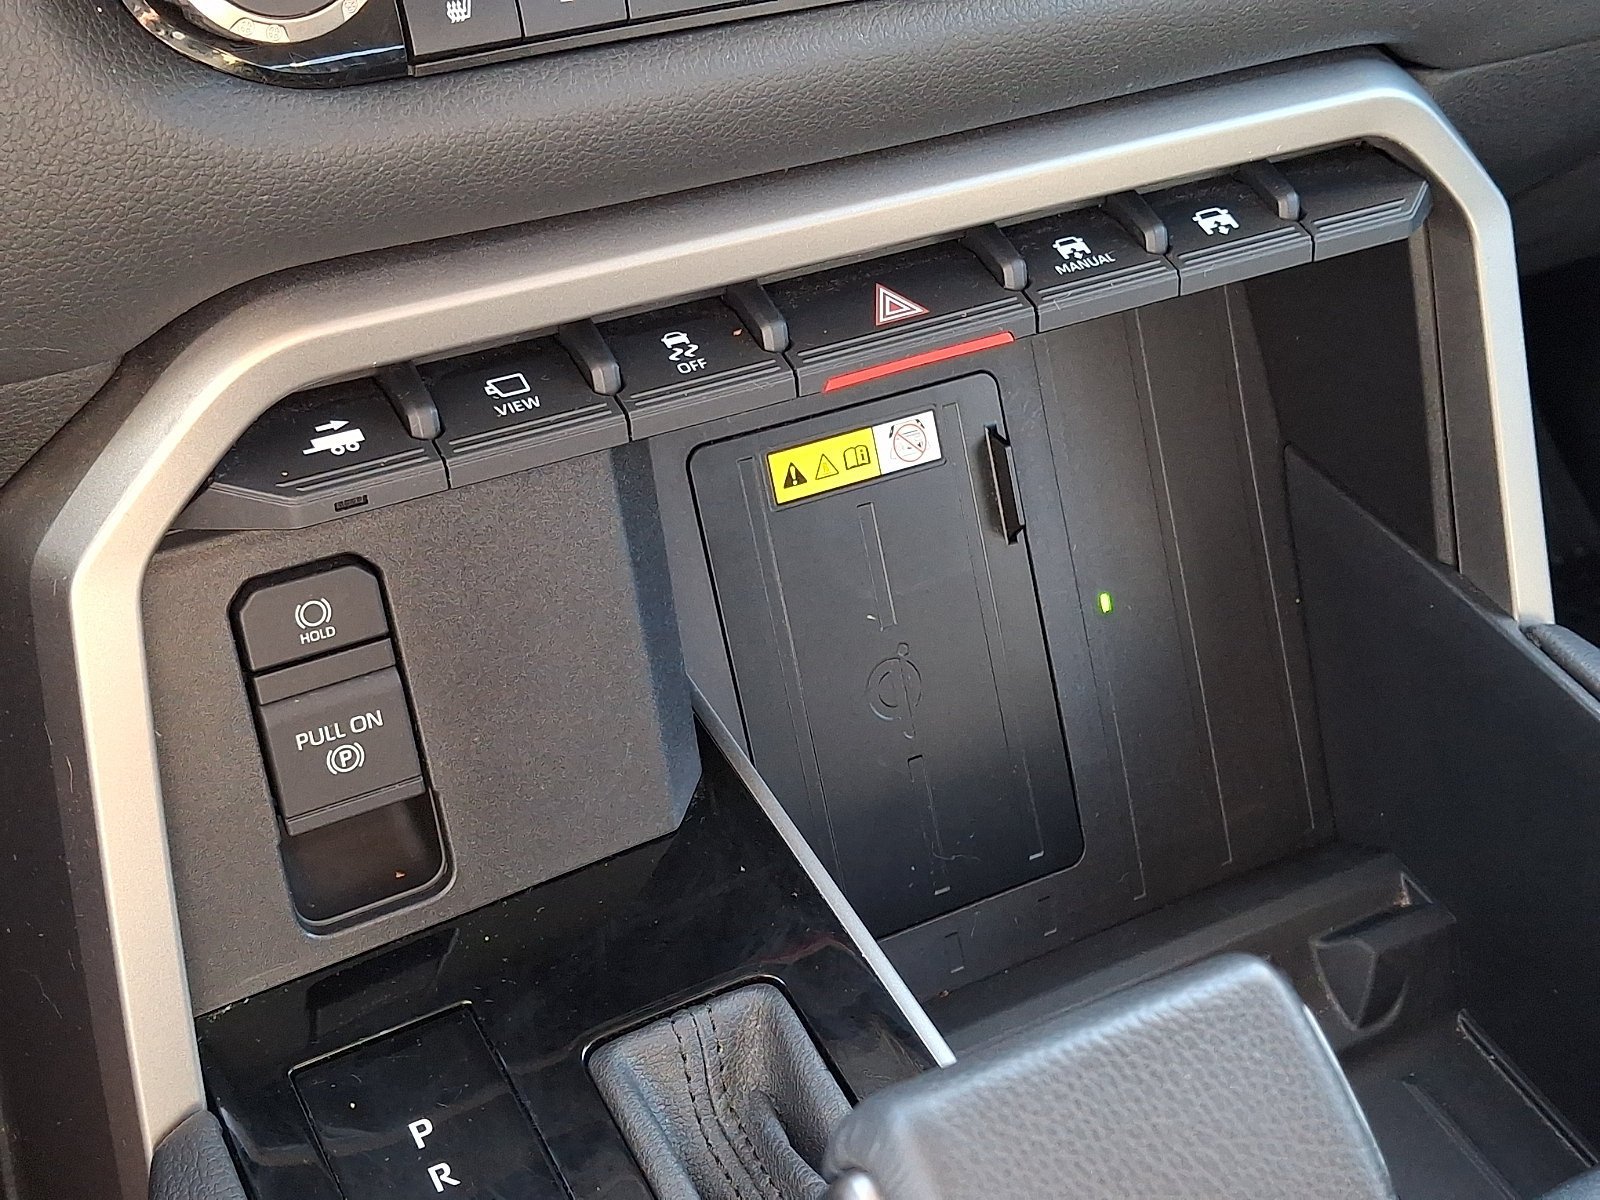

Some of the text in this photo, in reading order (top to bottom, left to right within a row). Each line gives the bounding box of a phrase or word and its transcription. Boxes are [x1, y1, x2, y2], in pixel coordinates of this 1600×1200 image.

[1054, 252, 1116, 275] MANUAL
[677, 358, 707, 374] OFF
[493, 395, 541, 416] VIEW
[300, 626, 336, 645] HOLD
[295, 709, 384, 751] PULL ON
[339, 749, 353, 768] P
[408, 1118, 434, 1150] P
[427, 1162, 462, 1193] R
